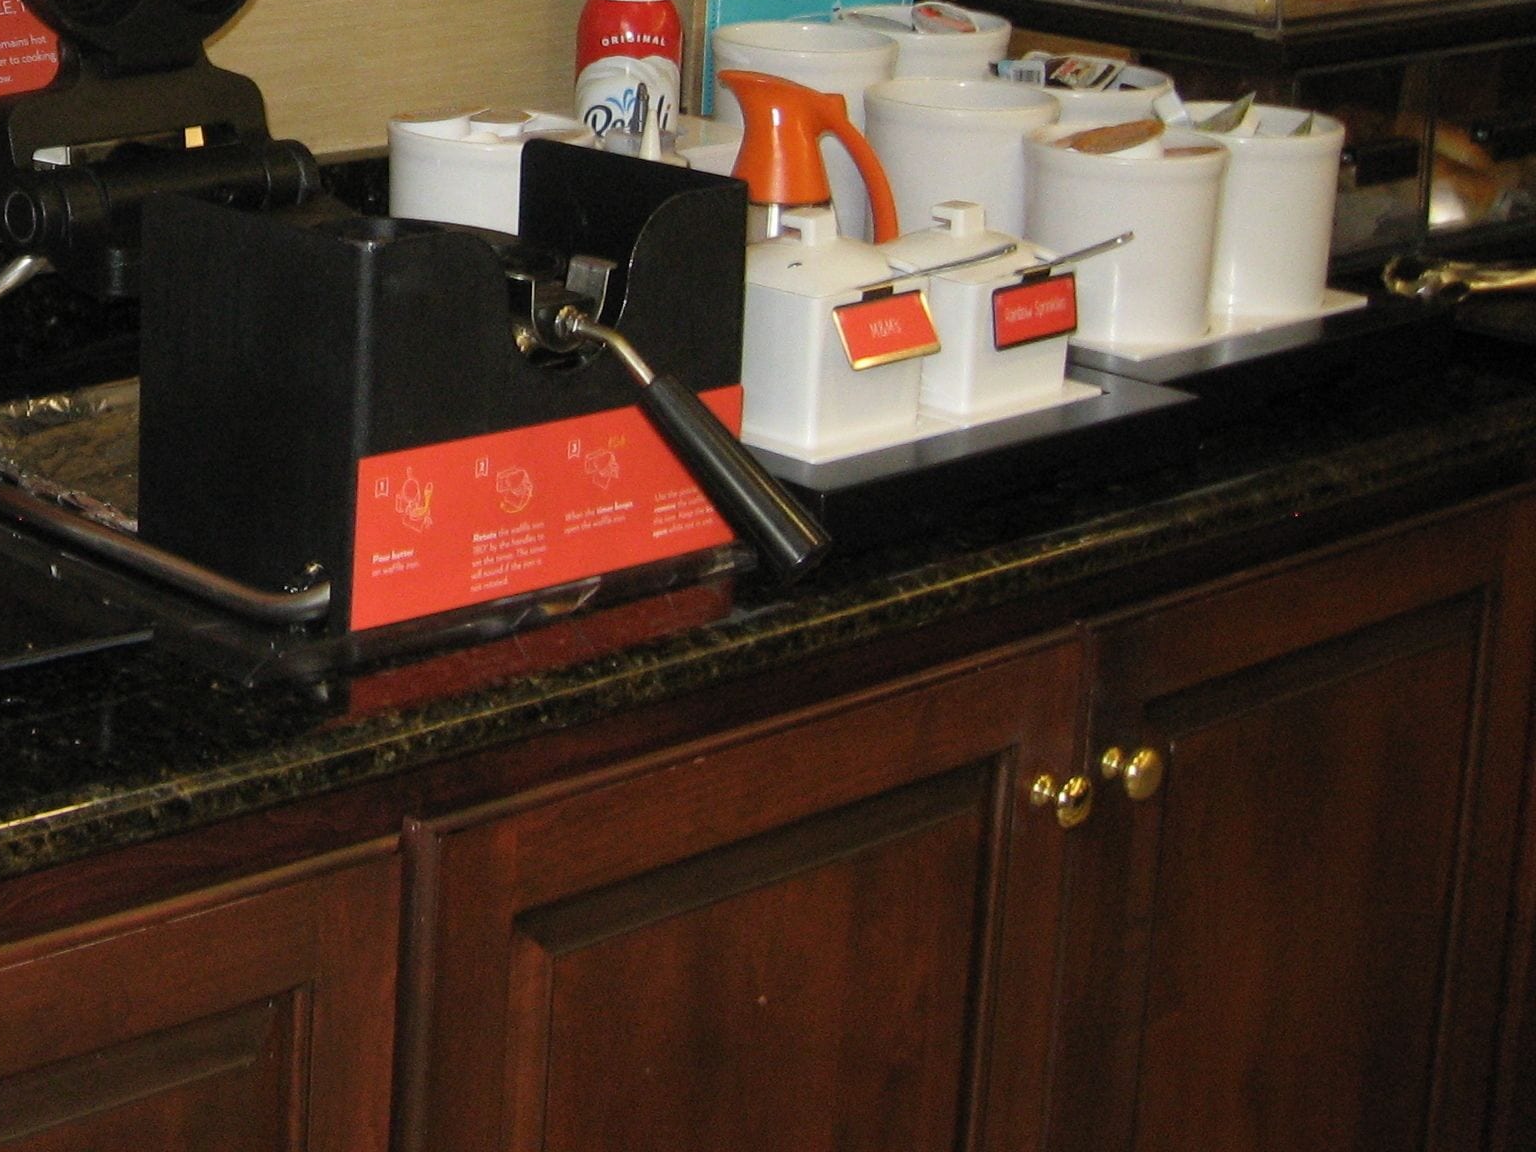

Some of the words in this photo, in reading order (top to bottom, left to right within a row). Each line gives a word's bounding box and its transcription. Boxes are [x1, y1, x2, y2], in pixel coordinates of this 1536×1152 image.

[30, 34, 47, 45] hot
[601, 34, 665, 47] ORIGINAL
[9, 55, 20, 66] to
[21, 49, 57, 64] cooking
